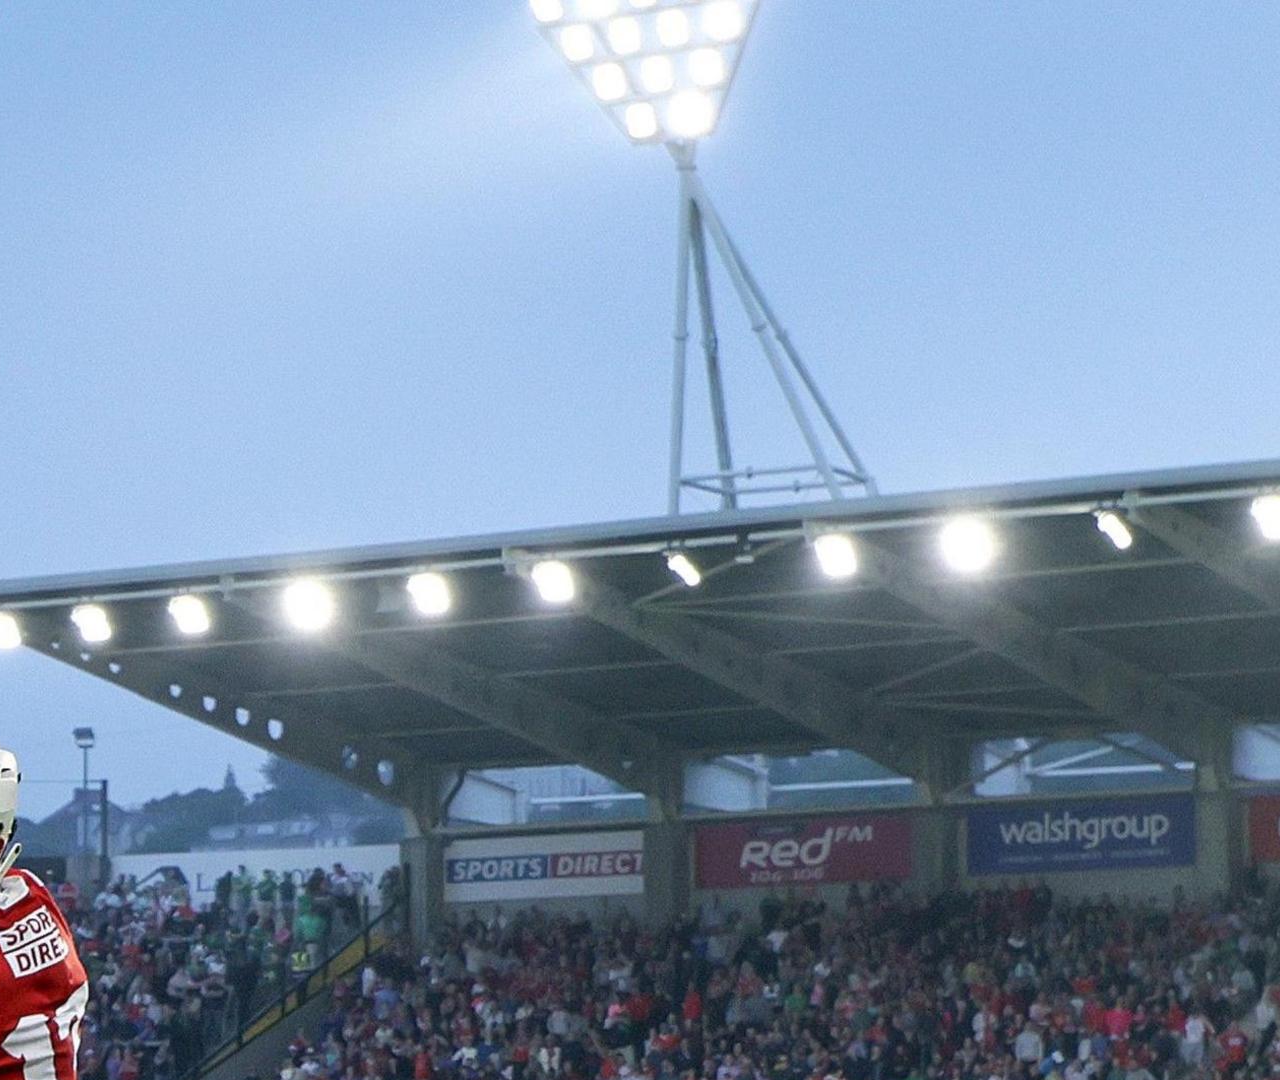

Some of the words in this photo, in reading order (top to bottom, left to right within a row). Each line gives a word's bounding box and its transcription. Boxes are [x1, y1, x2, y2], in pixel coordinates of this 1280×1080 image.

[999, 811, 1170, 850] walshgroup
[453, 857, 543, 882] SPORTS
[556, 852, 644, 876] DIRECT
